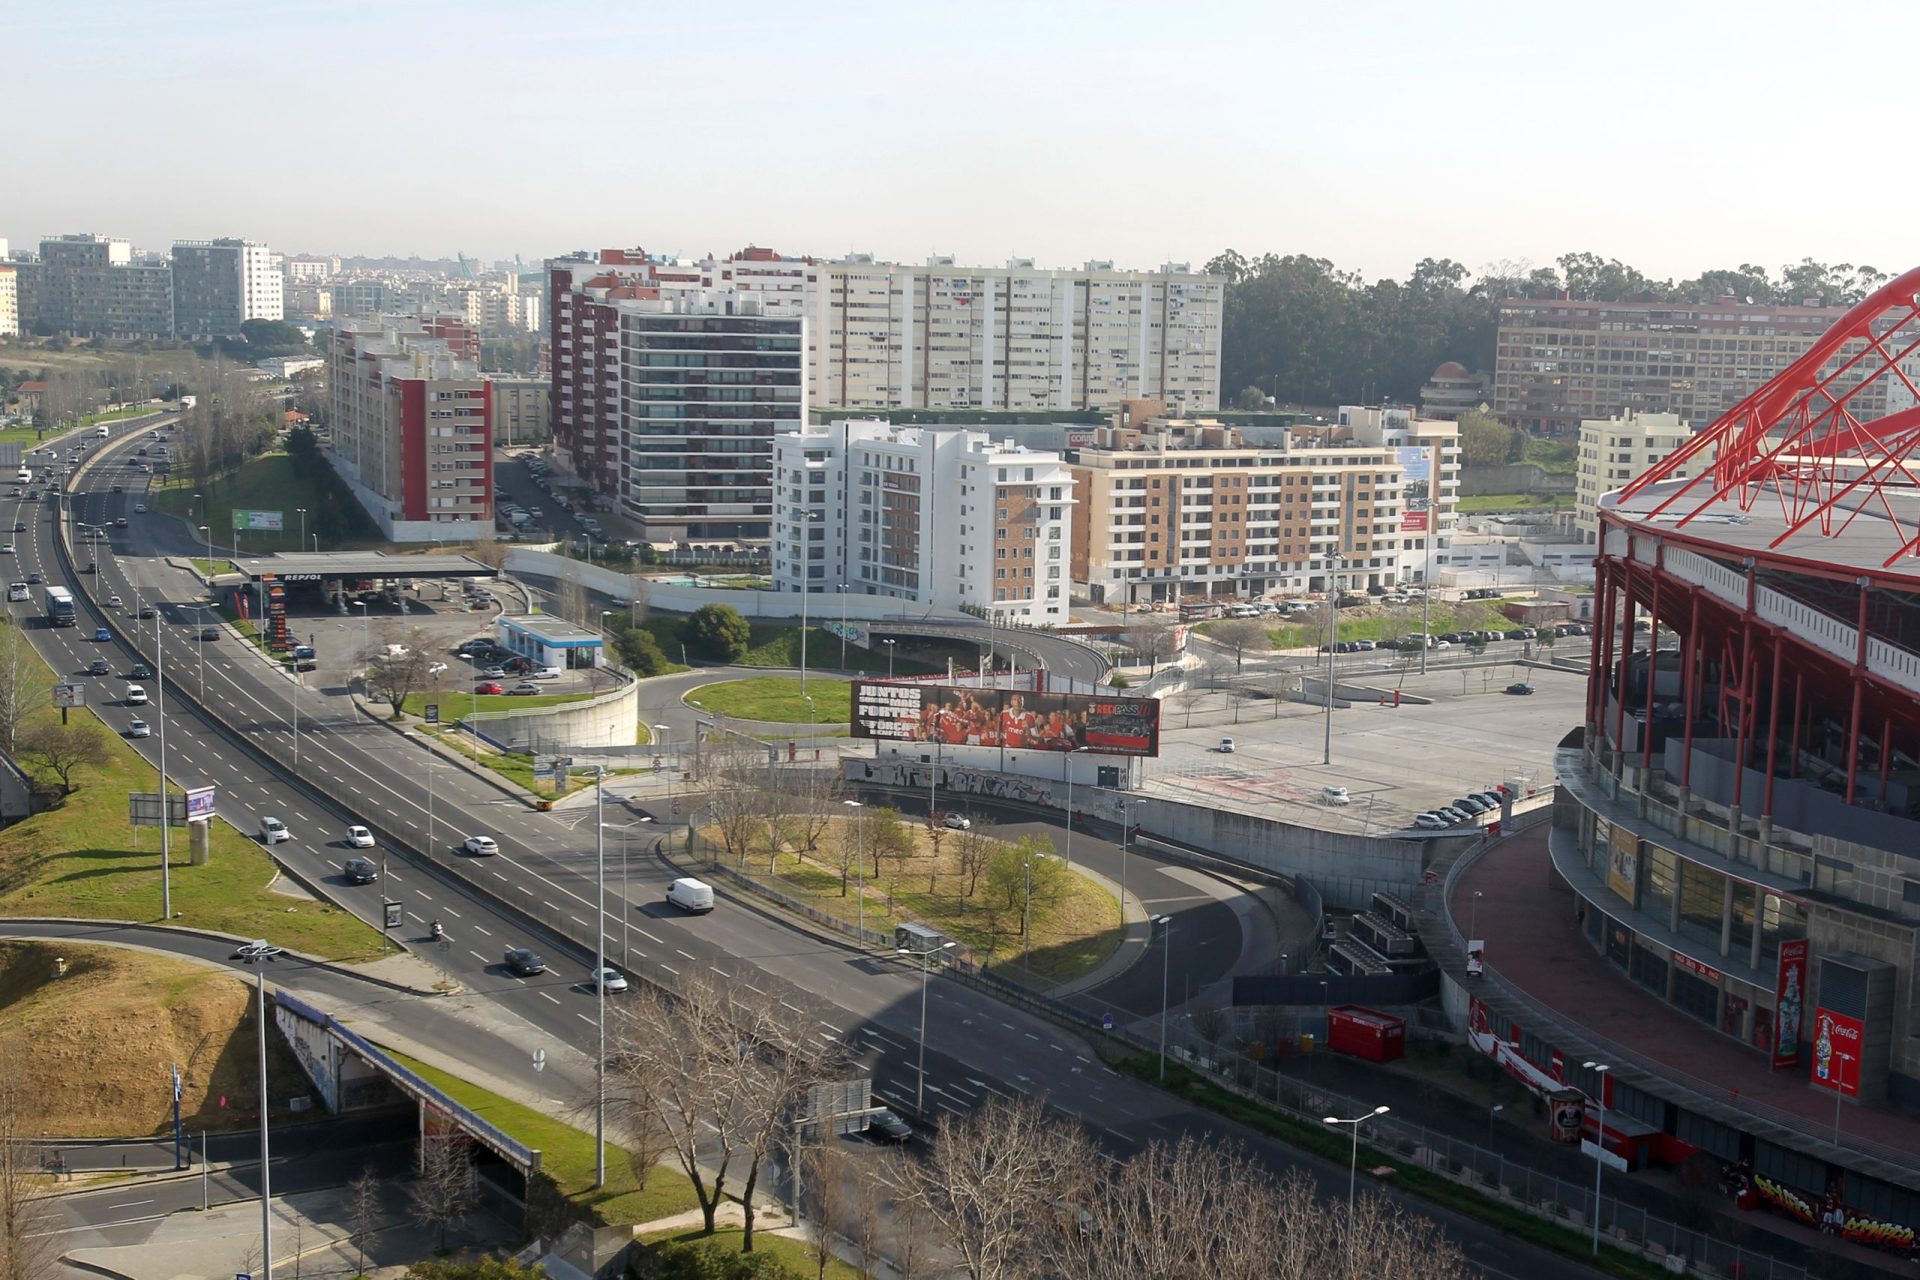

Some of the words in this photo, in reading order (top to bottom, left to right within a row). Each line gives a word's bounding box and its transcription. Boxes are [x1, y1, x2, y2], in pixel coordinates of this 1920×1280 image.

[859, 685, 921, 699] JUNTOS
[890, 698, 921, 708] MAIS
[858, 704, 921, 719] FORTES
[869, 729, 910, 737] BENFICA
